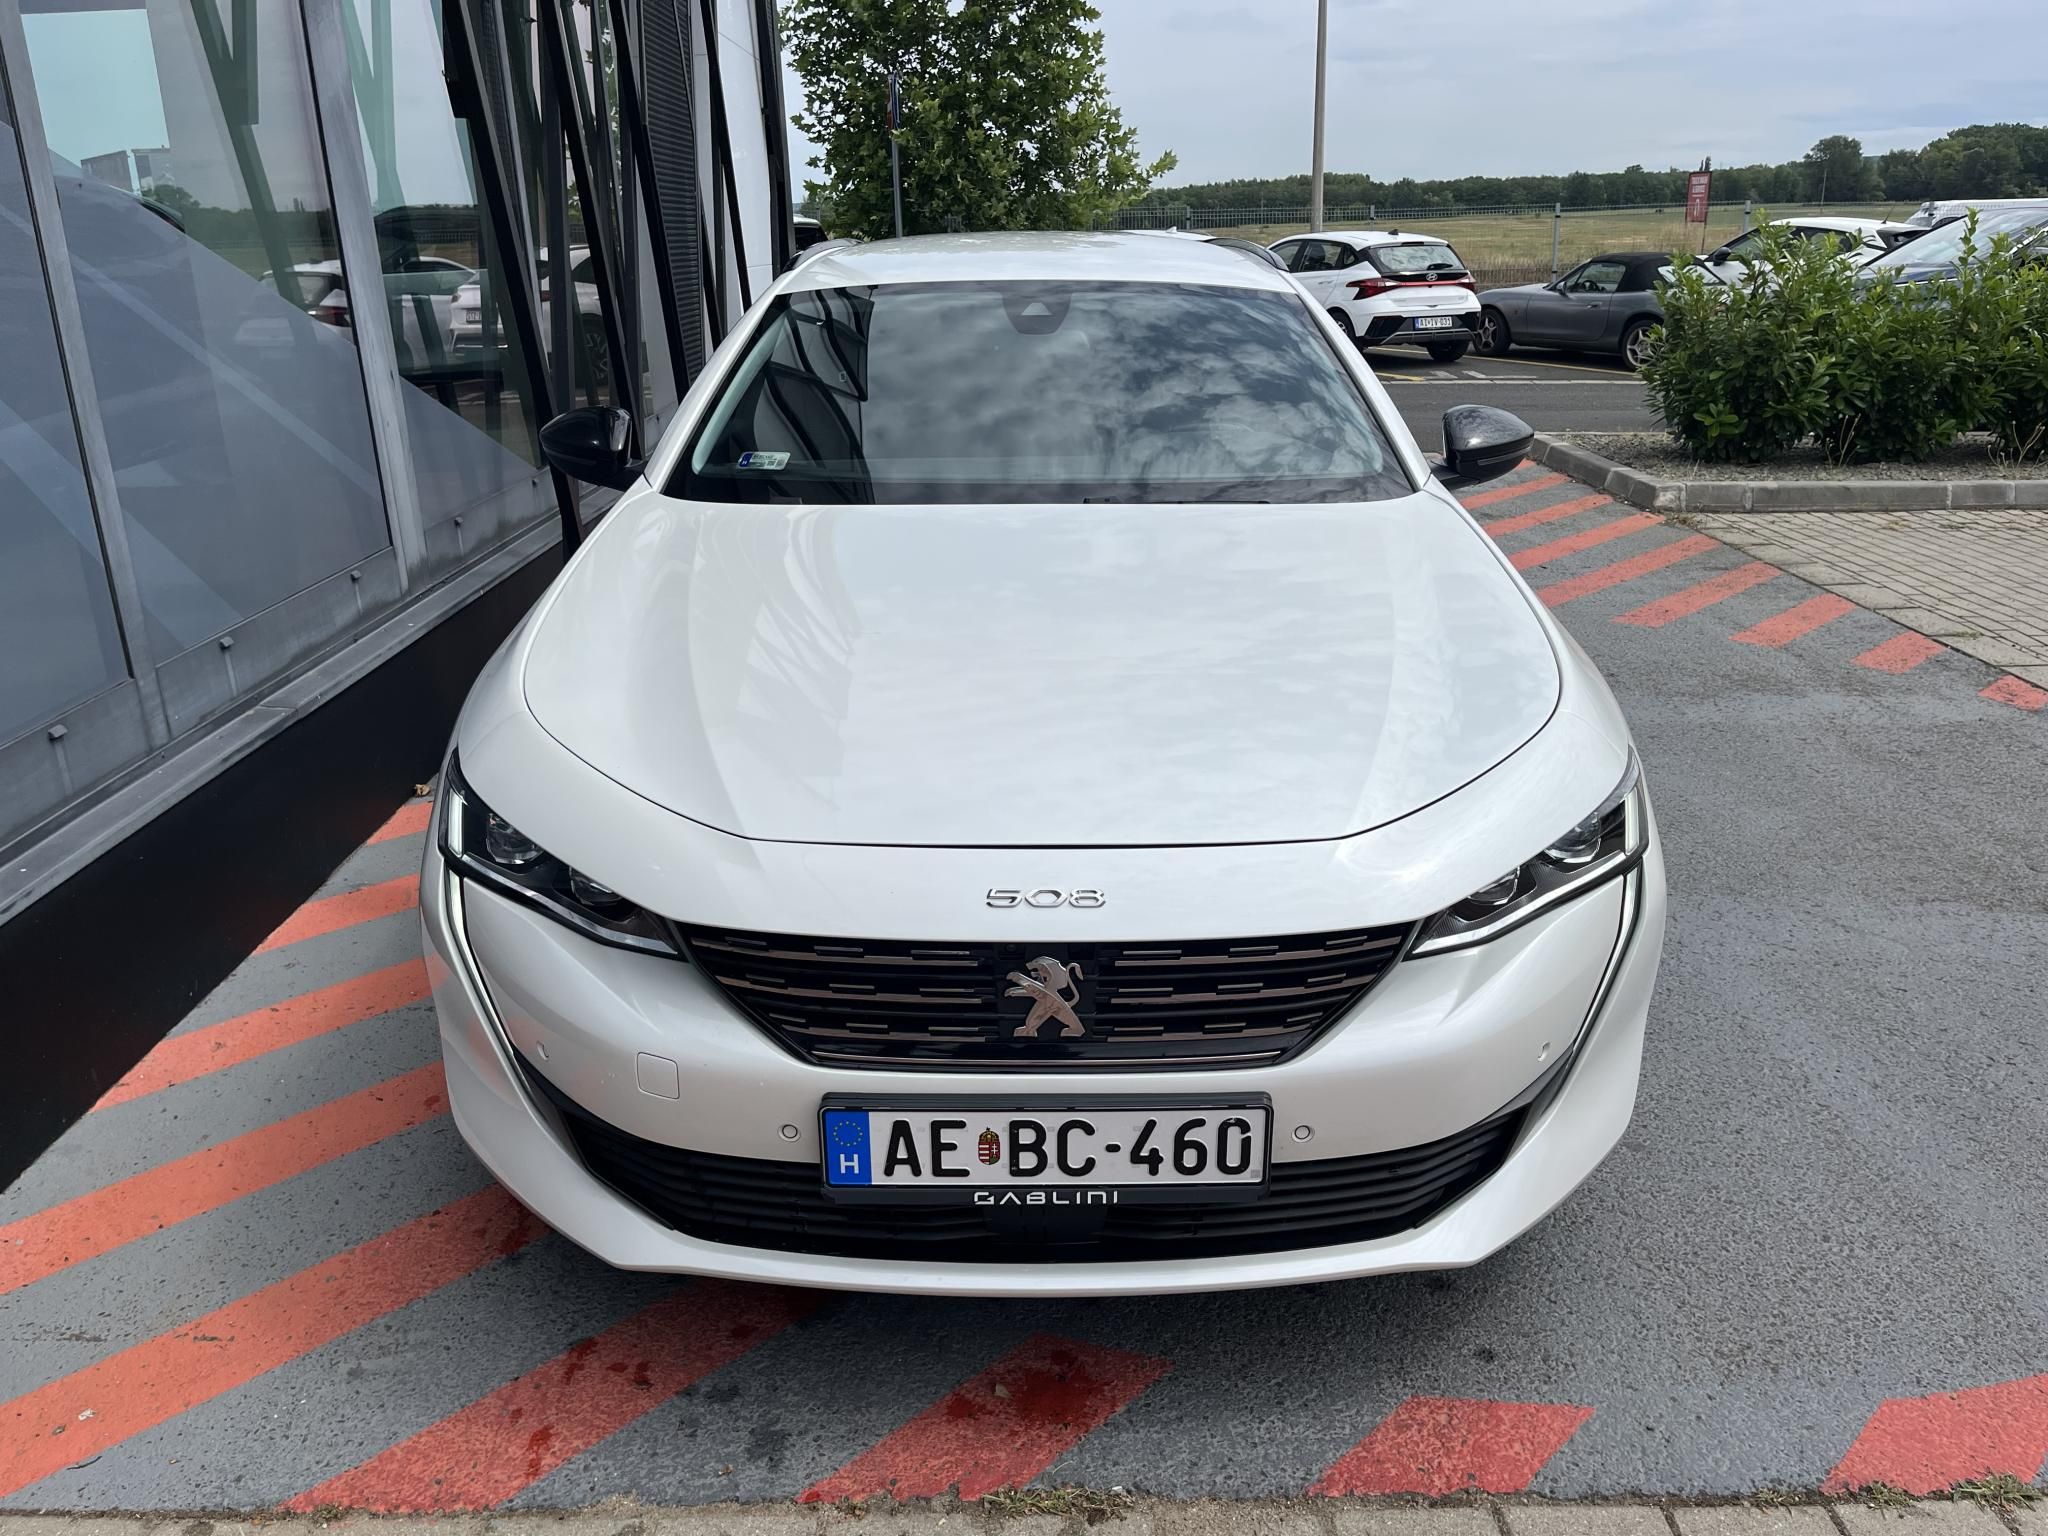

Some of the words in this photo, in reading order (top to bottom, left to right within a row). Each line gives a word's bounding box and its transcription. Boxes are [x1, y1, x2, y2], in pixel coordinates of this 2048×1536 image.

[985, 888, 1106, 909] 508
[840, 1153, 859, 1174] H
[884, 1119, 971, 1177] AE
[1008, 1117, 1253, 1177] BC-460
[974, 1190, 1118, 1206] GABLINI
